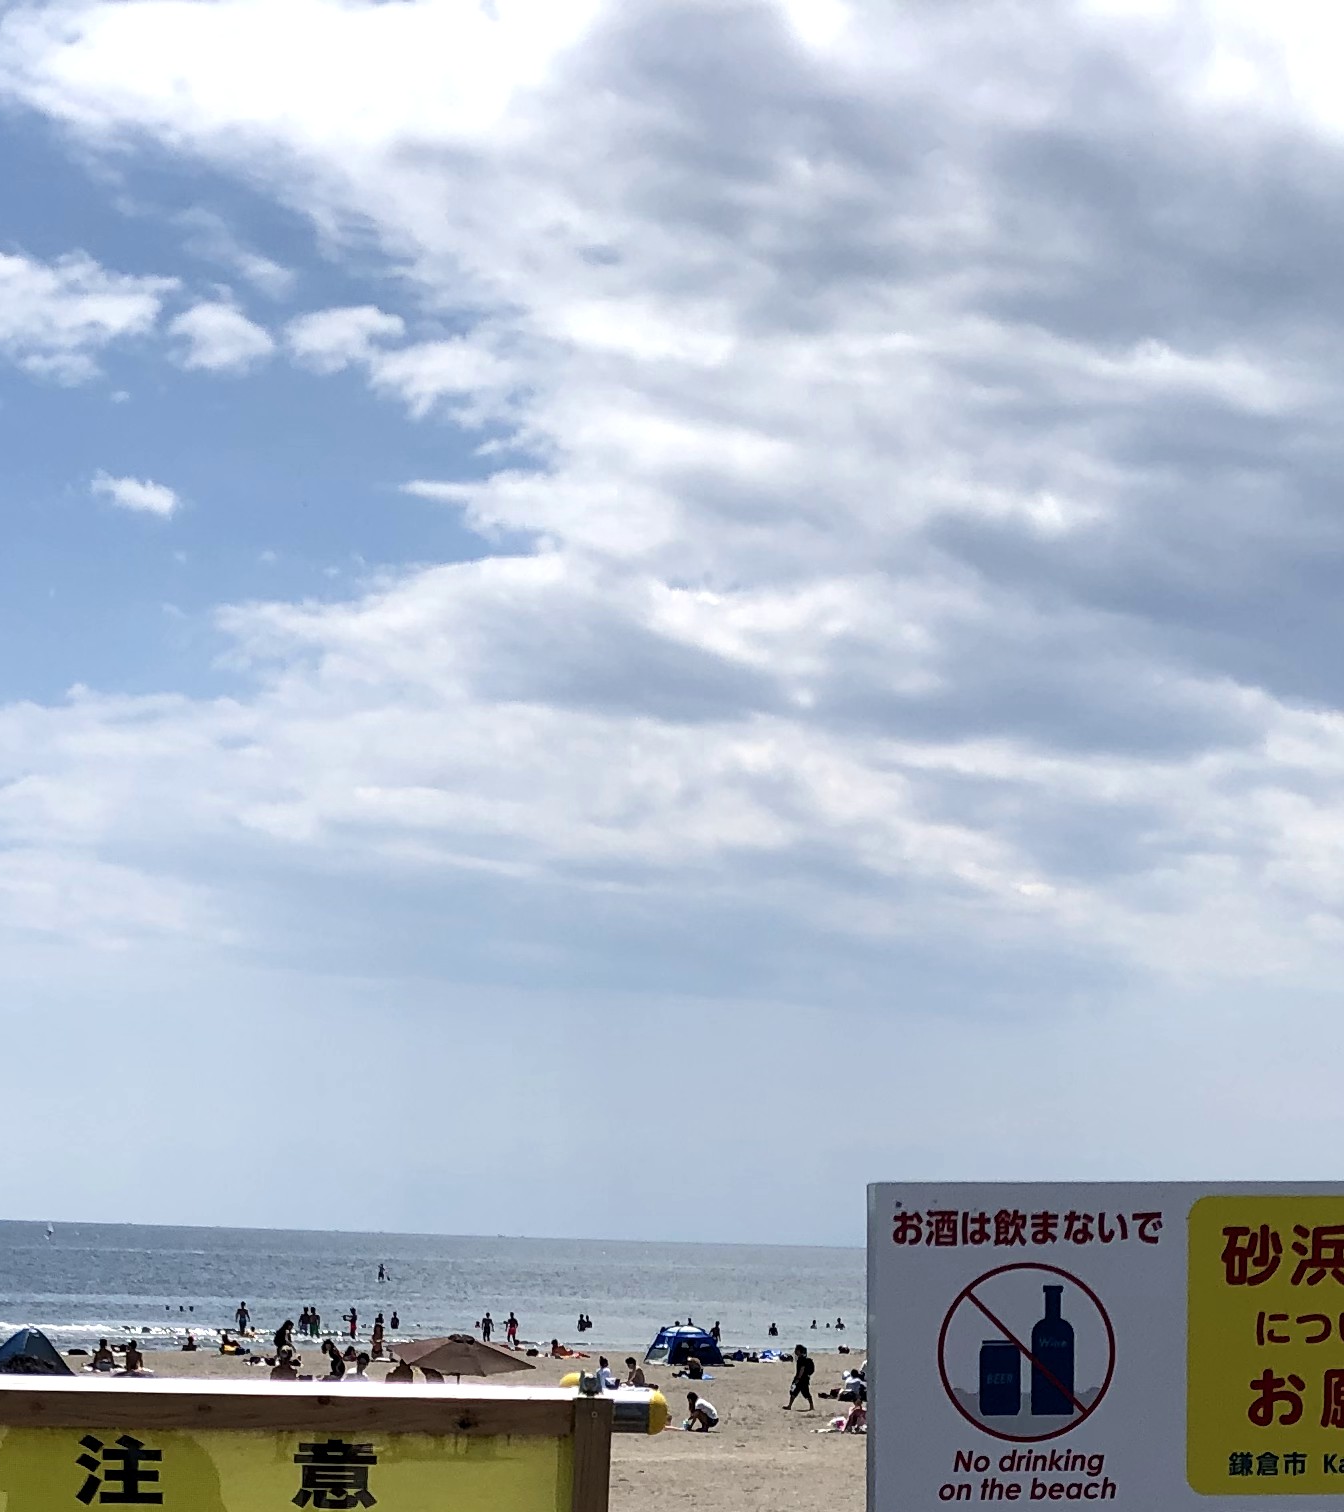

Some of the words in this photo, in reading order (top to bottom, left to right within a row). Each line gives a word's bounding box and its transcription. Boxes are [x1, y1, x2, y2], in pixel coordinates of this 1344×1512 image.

[891, 1210, 1164, 1248] お酒は飲まないで
[953, 1450, 990, 1473] No
[998, 1449, 1105, 1478] drinking
[1227, 1451, 1308, 1478] 鎌倉市
[938, 1479, 971, 1501] on
[980, 1478, 1024, 1501] the
[1029, 1477, 1117, 1501] beach
